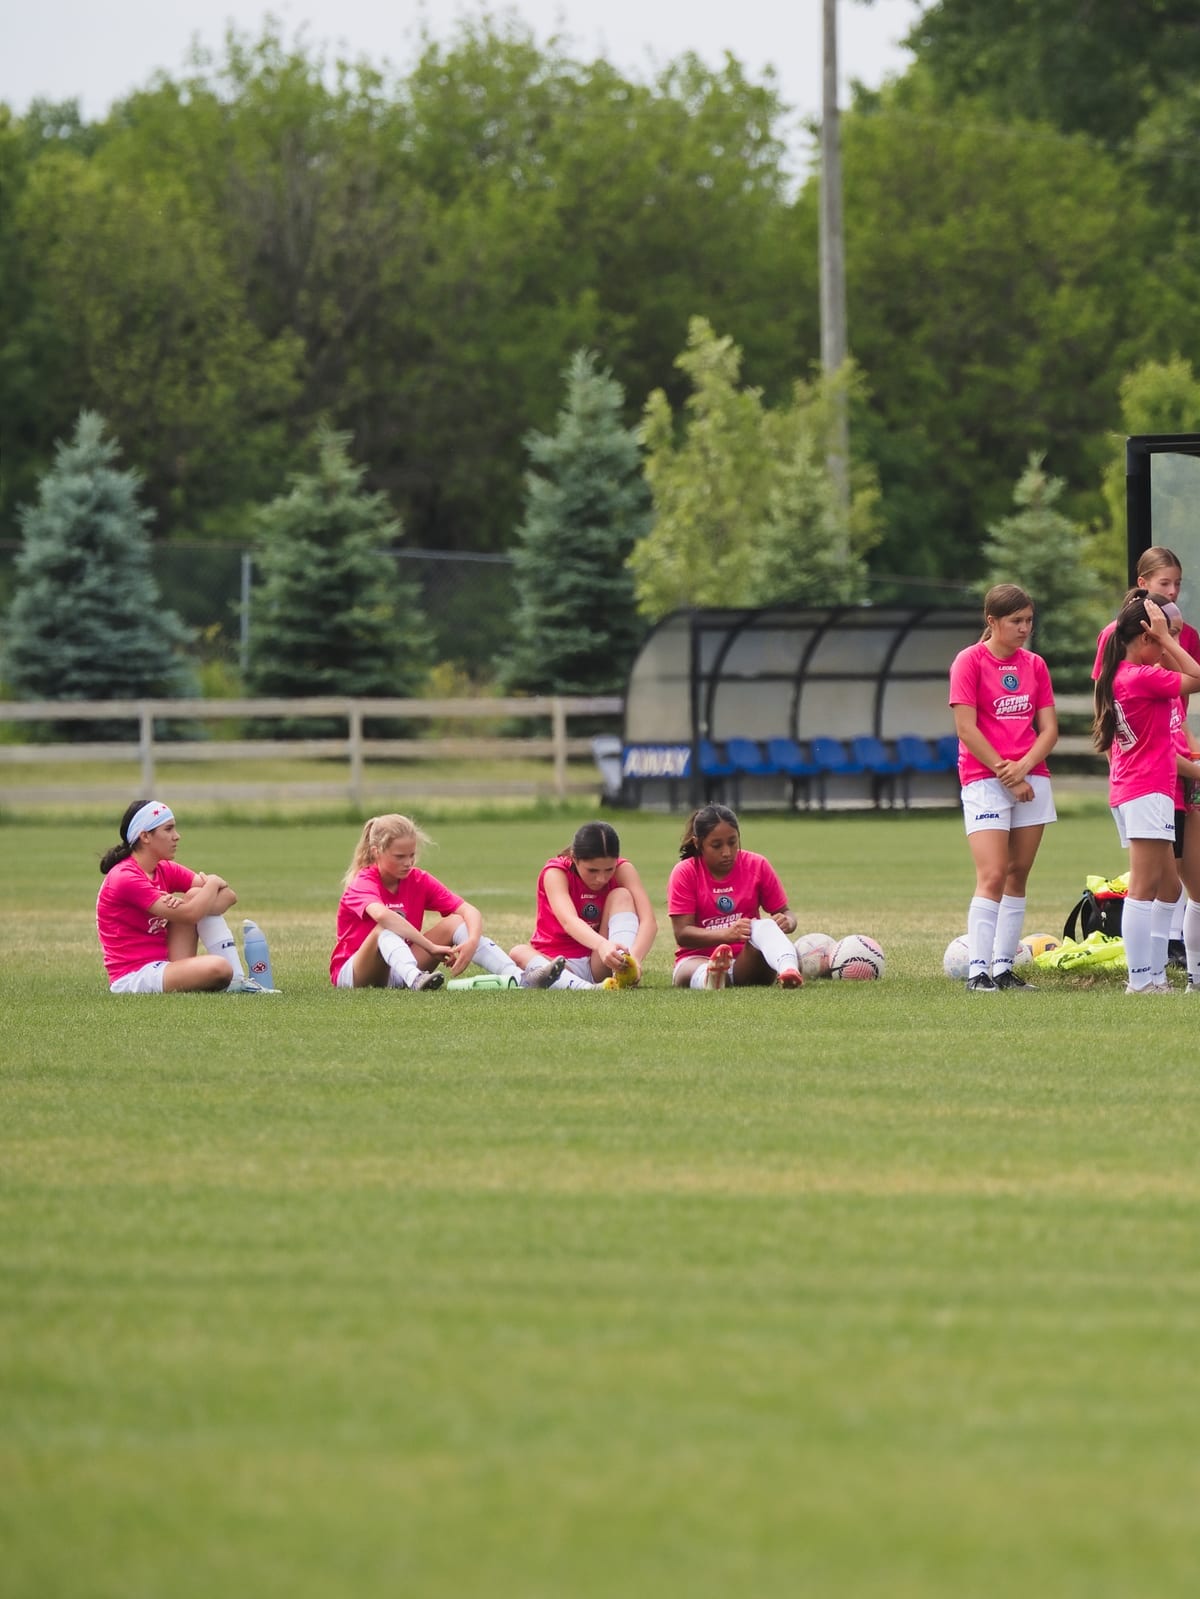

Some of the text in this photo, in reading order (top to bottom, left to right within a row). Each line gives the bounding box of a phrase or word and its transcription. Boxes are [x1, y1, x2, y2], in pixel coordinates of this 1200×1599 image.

[998, 695, 1029, 708] ACTION
[995, 703, 1028, 716] SPORTS
[623, 747, 691, 777] AWAY
[975, 813, 1000, 821] LEGEA
